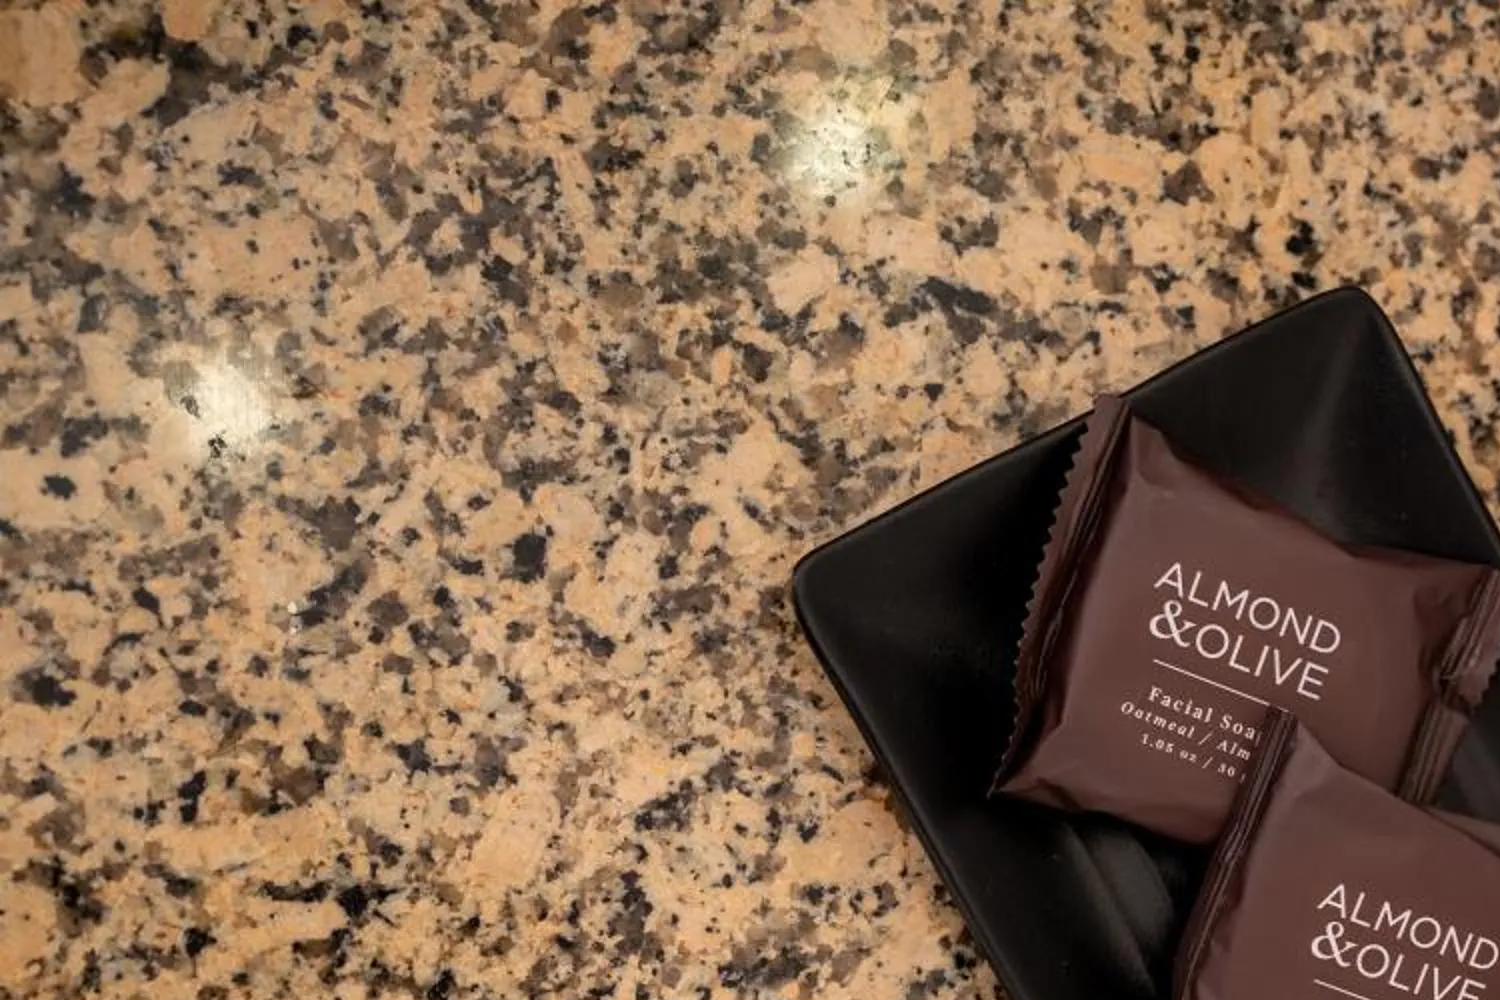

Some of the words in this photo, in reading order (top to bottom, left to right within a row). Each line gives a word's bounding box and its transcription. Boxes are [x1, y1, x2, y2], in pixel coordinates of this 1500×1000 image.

[1154, 561, 1341, 653] ALMOND
[1149, 600, 1329, 700] &OLIVE
[1121, 701, 1195, 739] Oatmeal
[1199, 732, 1212, 745] /
[1217, 739, 1251, 761] Alm
[1148, 686, 1213, 723] Facial
[1140, 733, 1173, 753] 1.05
[1179, 750, 1197, 762] oz
[1202, 756, 1212, 769] /
[1217, 762, 1236, 778] 30
[1317, 883, 1500, 969] ALMOND
